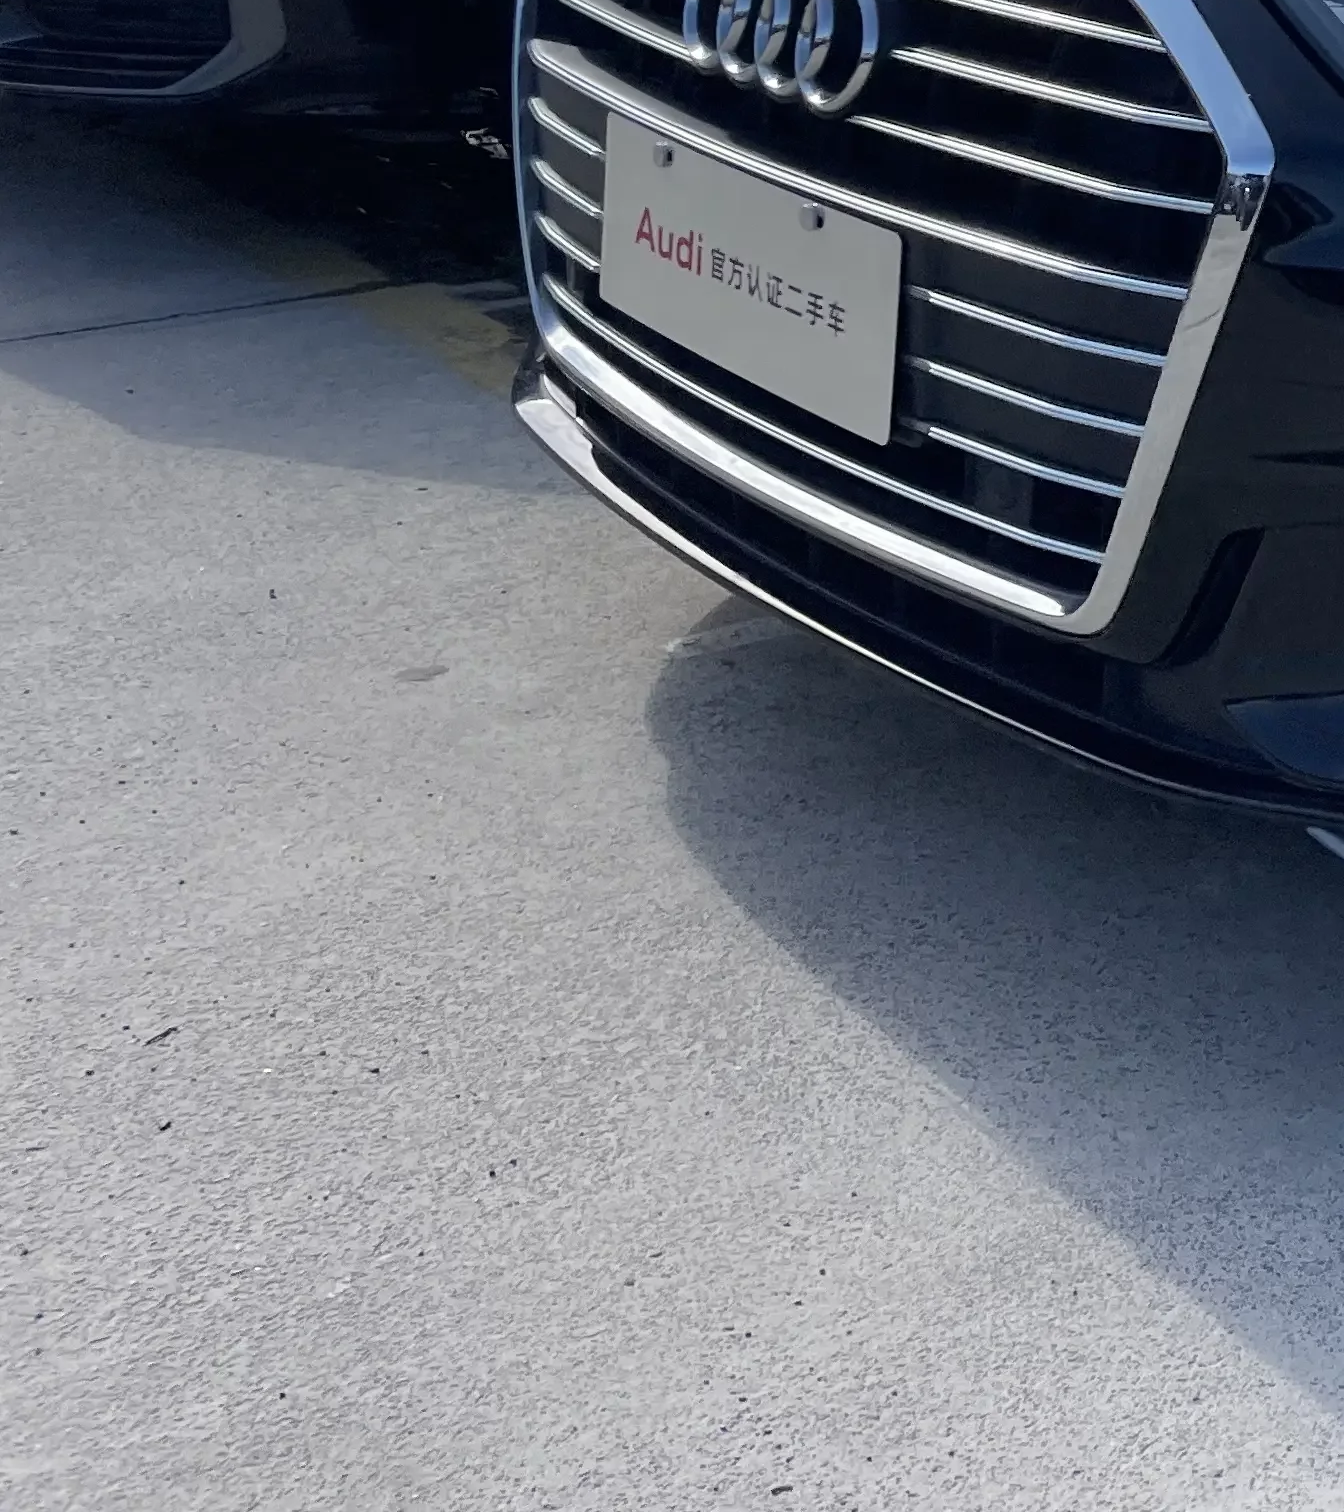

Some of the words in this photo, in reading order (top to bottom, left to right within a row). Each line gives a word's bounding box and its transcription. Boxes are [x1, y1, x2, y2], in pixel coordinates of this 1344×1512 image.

[635, 206, 703, 276] Audi
[711, 248, 846, 337] 官方认证二手车
